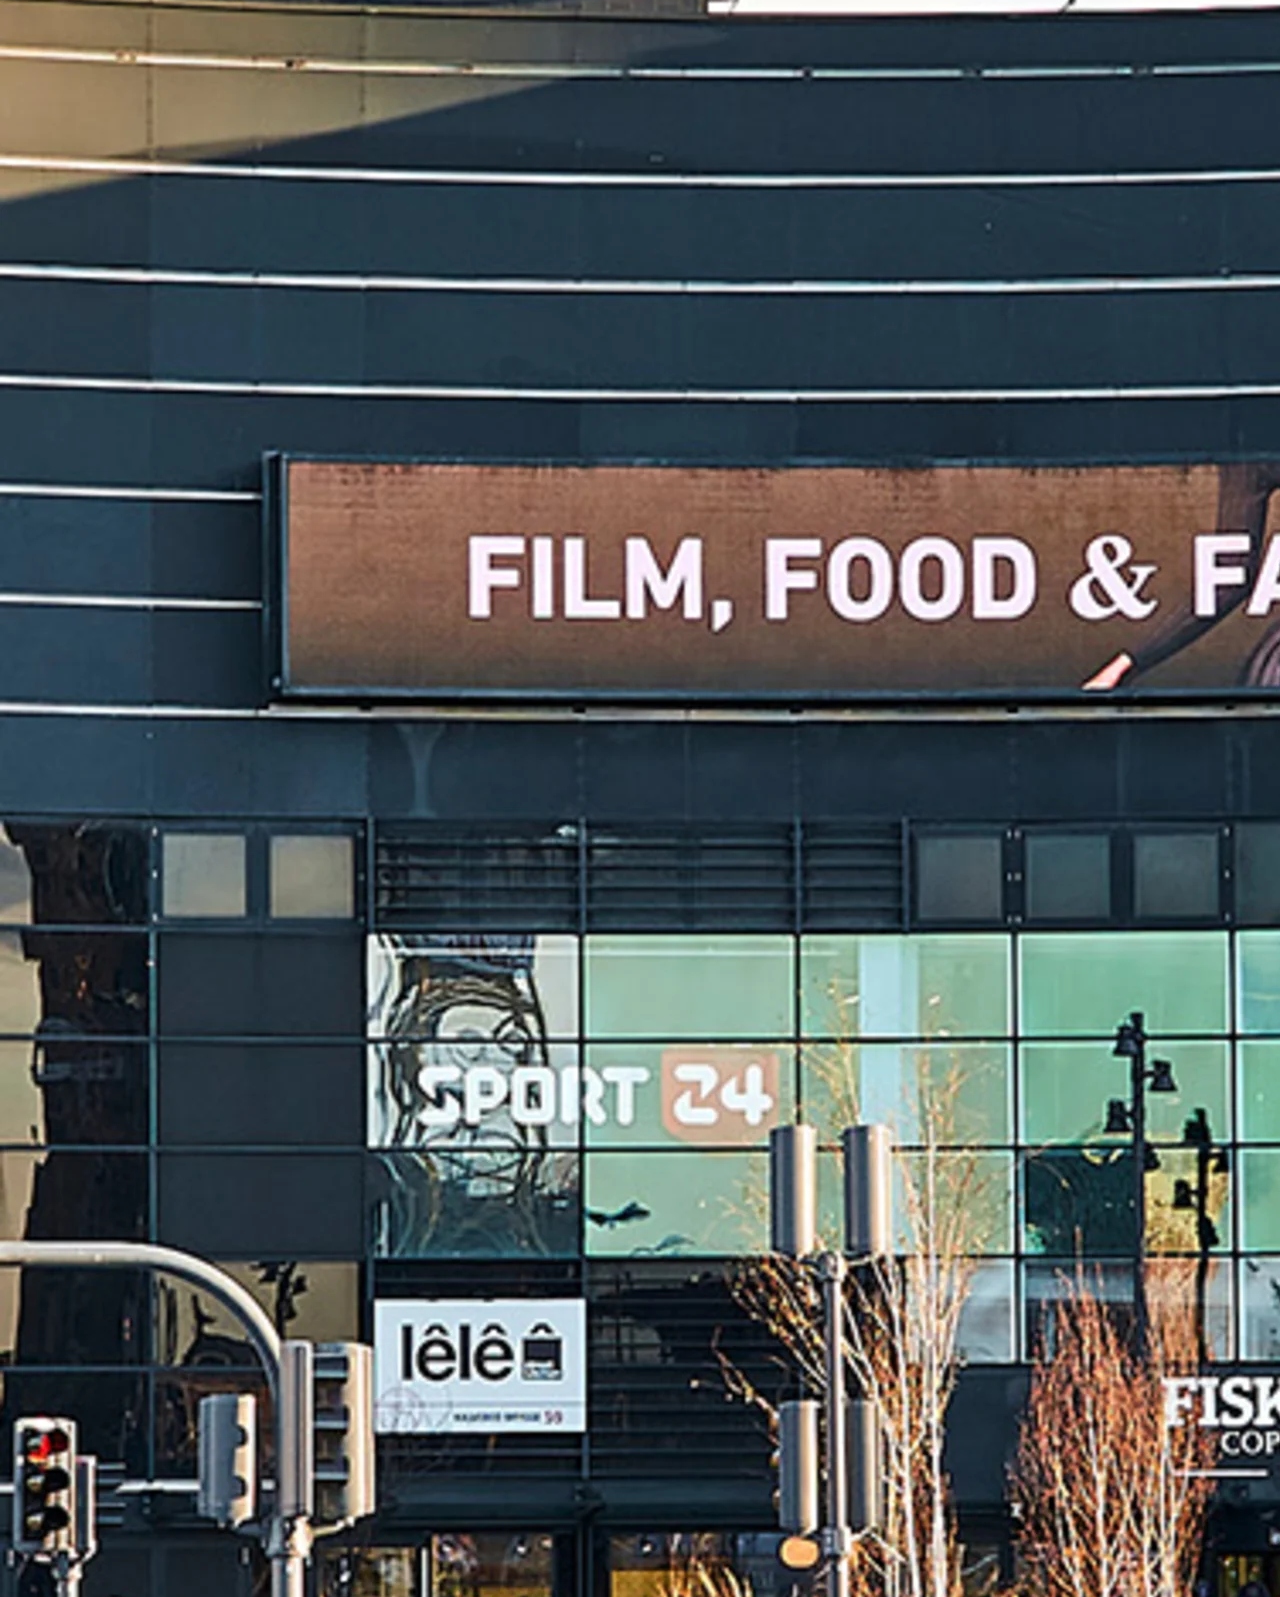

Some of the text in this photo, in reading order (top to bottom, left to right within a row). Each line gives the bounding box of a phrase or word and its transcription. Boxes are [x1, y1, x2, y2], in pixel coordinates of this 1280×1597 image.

[467, 536, 734, 632] FILM,
[765, 536, 1037, 621] FOOD
[1069, 535, 1157, 620] &
[418, 1064, 774, 1127] SPORT 24
